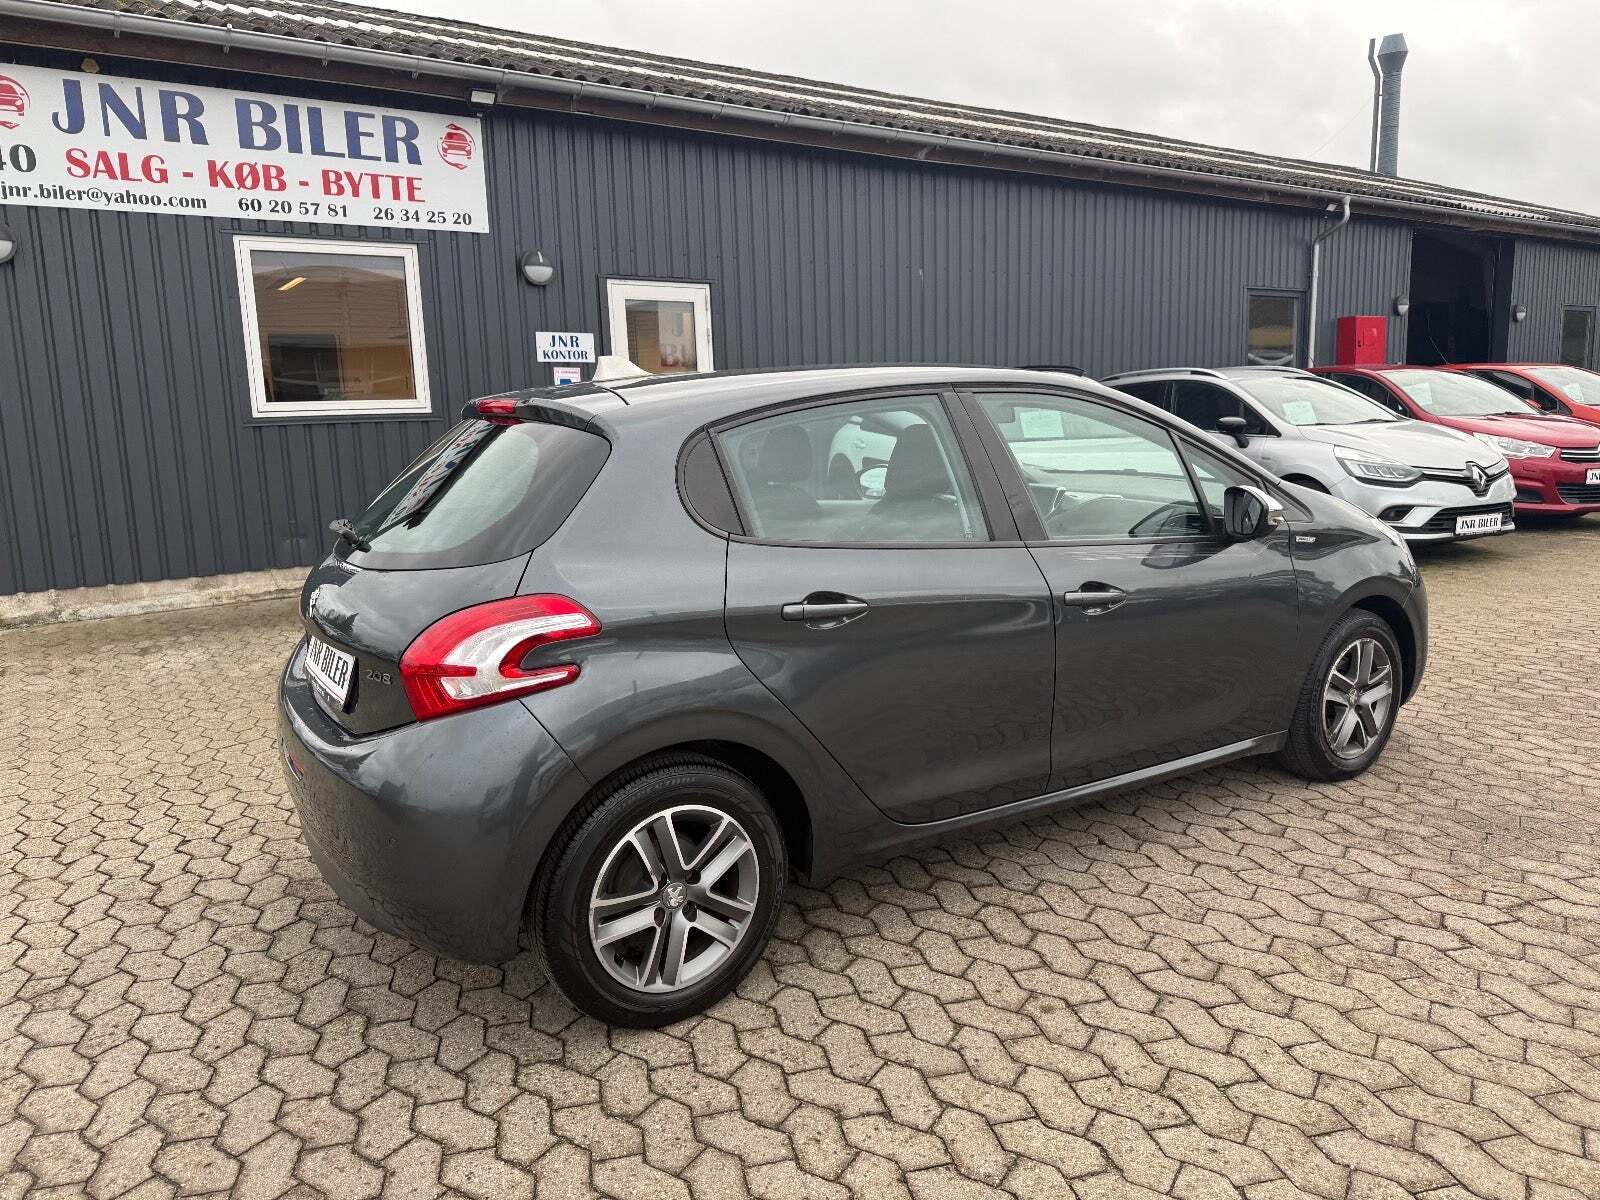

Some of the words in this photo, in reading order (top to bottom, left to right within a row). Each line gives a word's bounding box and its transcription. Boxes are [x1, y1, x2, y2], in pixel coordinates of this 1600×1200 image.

[52, 78, 209, 146] JNR
[234, 97, 423, 165] BILER
[0, 143, 37, 173] 0
[65, 147, 169, 184] SALG
[207, 159, 289, 192] KØB
[321, 168, 426, 203] BYTTE
[1, 181, 207, 209] jnr.biler@yahoo.com
[238, 197, 263, 212] 60
[268, 199, 292, 214] 20
[299, 201, 321, 216] 57
[327, 203, 348, 217] 81
[373, 206, 395, 221] 26
[400, 208, 420, 222] 34
[426, 210, 447, 224] 25
[452, 212, 472, 225] 20
[549, 335, 580, 348] JNR
[543, 349, 588, 360] KONTOR
[1460, 519, 1476, 529] JNR
[1478, 517, 1499, 528] BILER
[321, 645, 349, 690] BILER
[366, 669, 391, 685] 208
